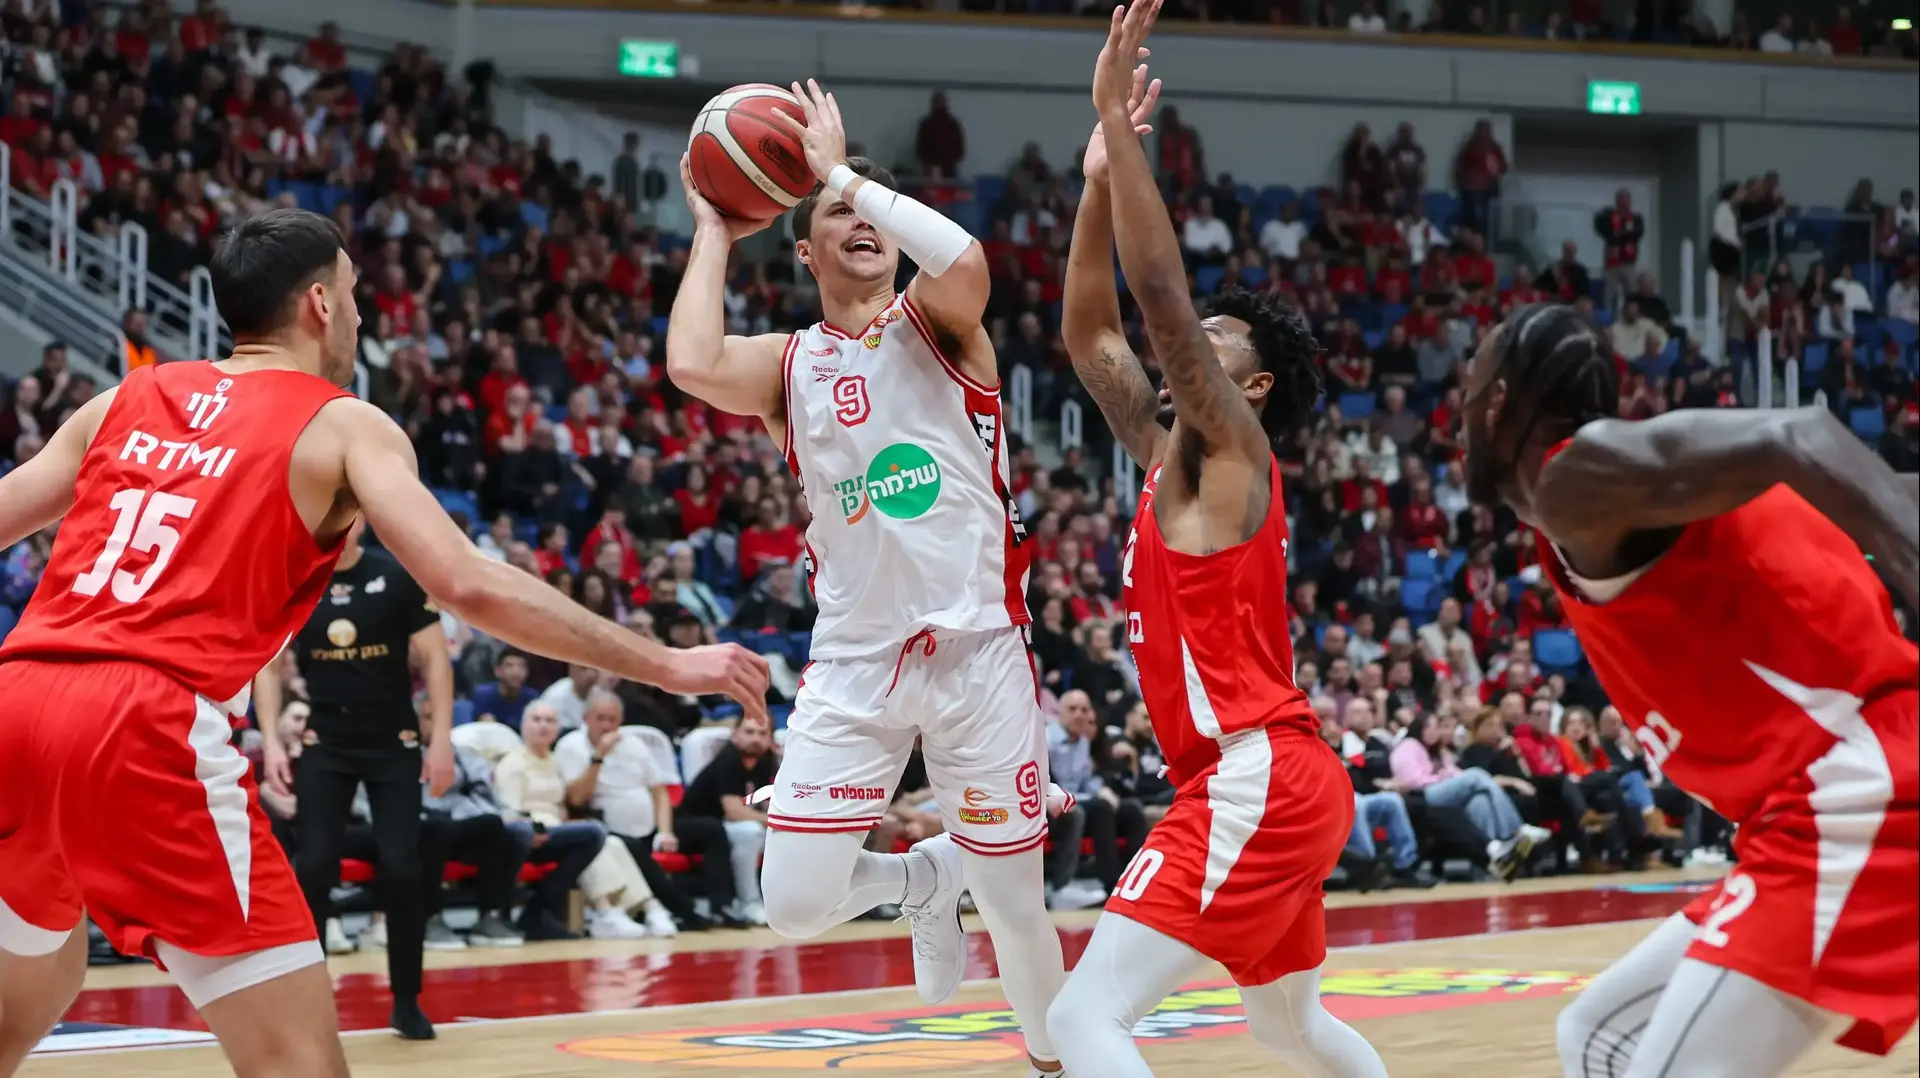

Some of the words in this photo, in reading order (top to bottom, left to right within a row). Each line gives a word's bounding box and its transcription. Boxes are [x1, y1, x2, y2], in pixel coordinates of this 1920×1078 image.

[186, 389, 229, 430] לוי
[833, 375, 871, 428] 9
[119, 430, 237, 478] RTMI
[867, 462, 938, 501] שלמה
[71, 488, 198, 603] 15
[791, 782, 822, 791] Reebok
[1015, 760, 1042, 819] 9
